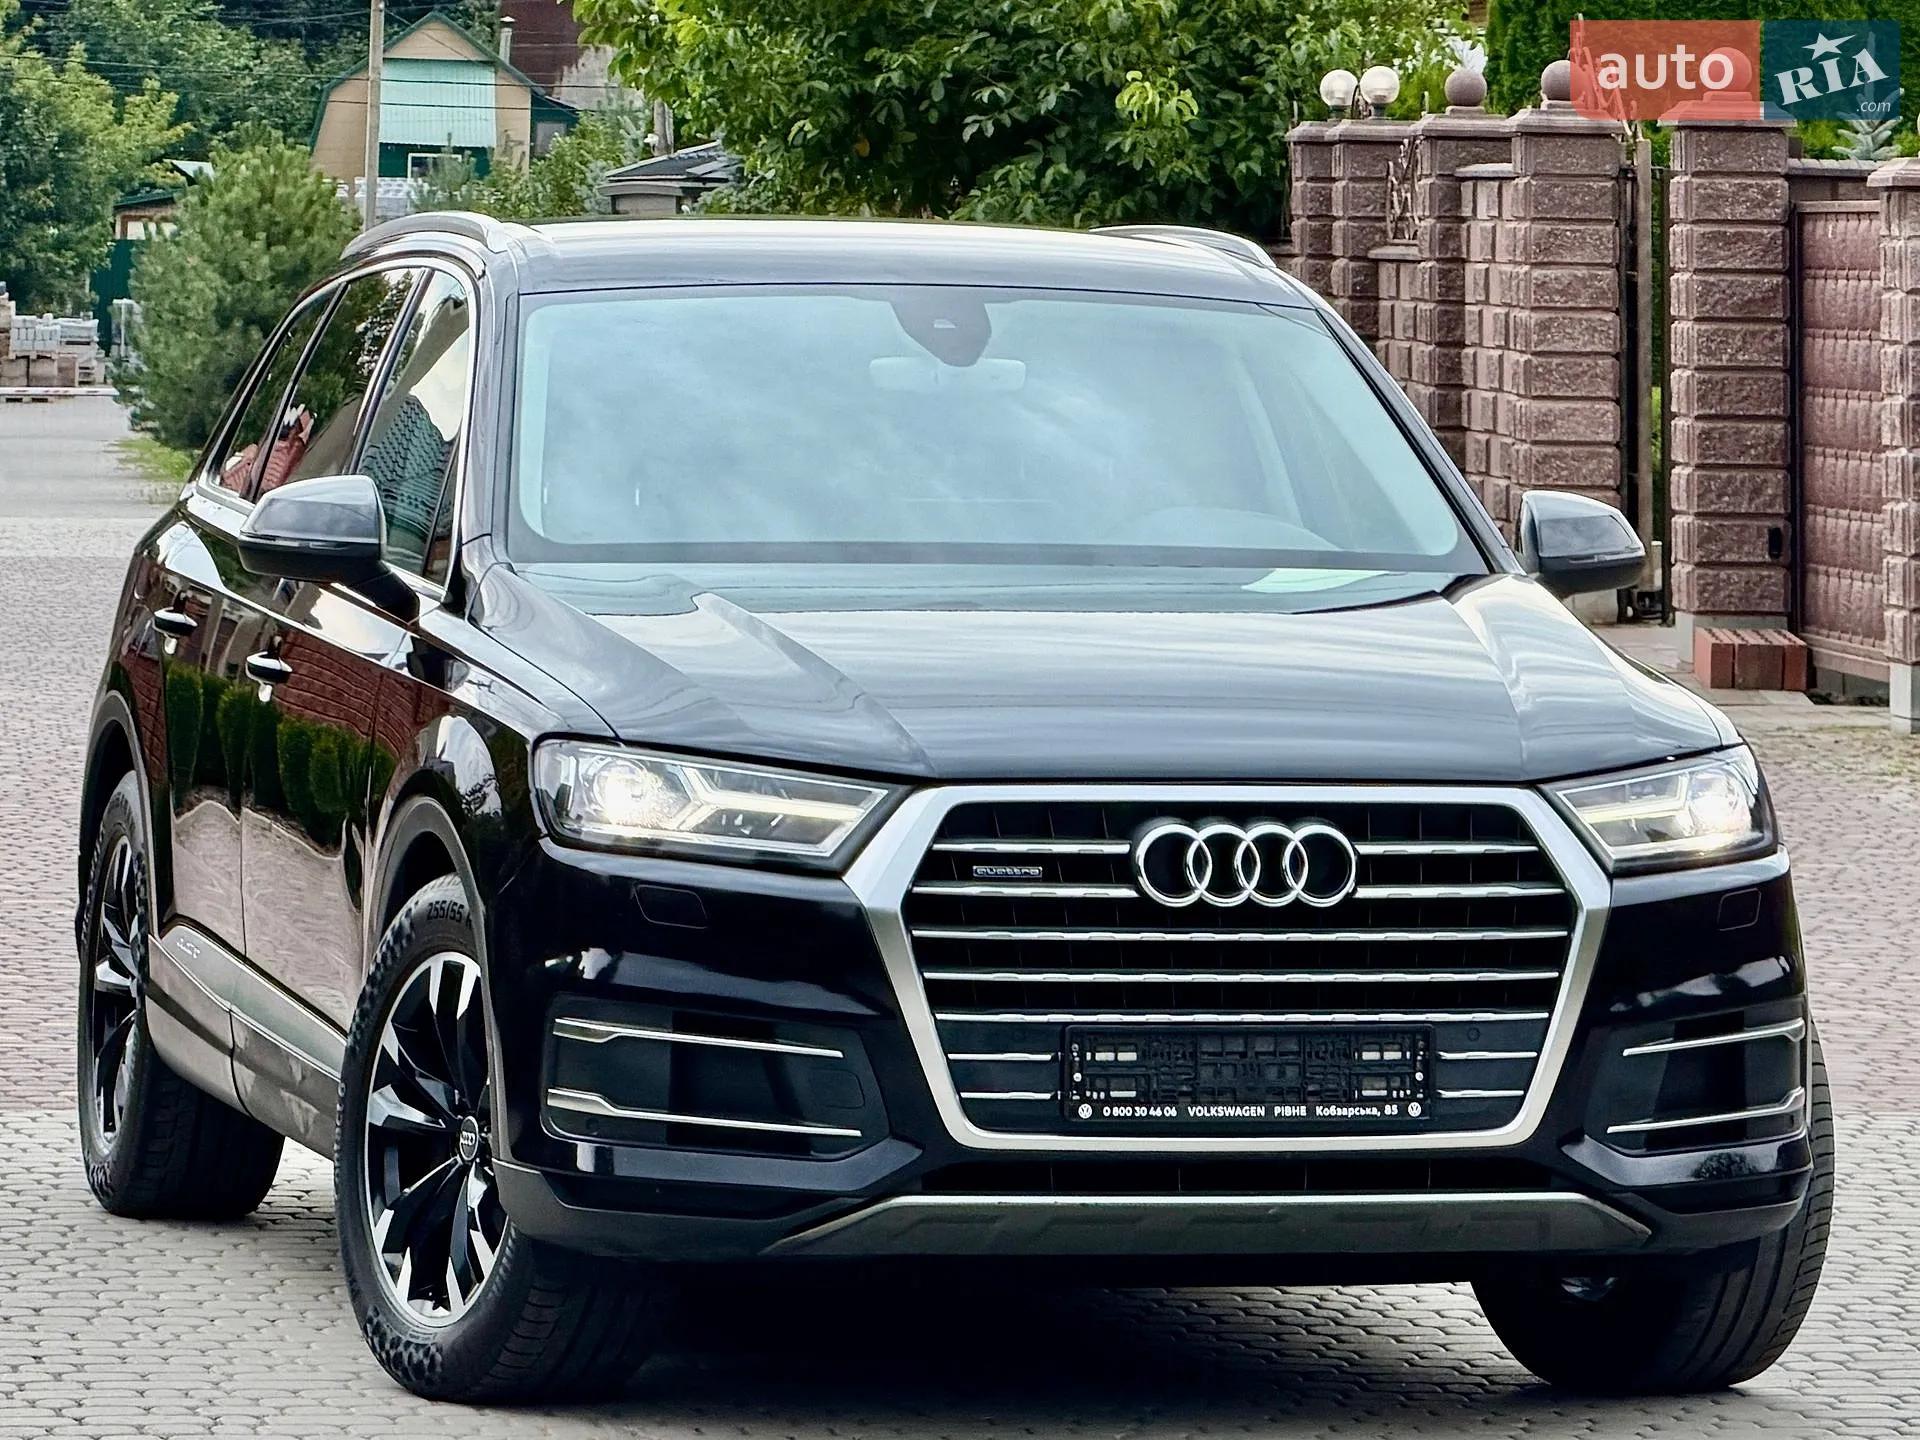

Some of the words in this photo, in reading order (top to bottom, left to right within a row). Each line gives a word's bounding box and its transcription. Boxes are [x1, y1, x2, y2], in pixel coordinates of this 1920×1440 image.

[976, 866, 1040, 875] quattro
[426, 900, 465, 923] 255/55
[1102, 1106, 1111, 1117] 0
[1112, 1106, 1133, 1117] 800
[1134, 1106, 1148, 1117] 30
[1148, 1106, 1162, 1117] 46
[1163, 1106, 1178, 1117] 06
[1187, 1106, 1266, 1117] VOLKSWAGEN
[1273, 1106, 1307, 1117] РІВНЕ
[1315, 1105, 1381, 1118] Кобзарська,
[1384, 1104, 1399, 1116] 85
